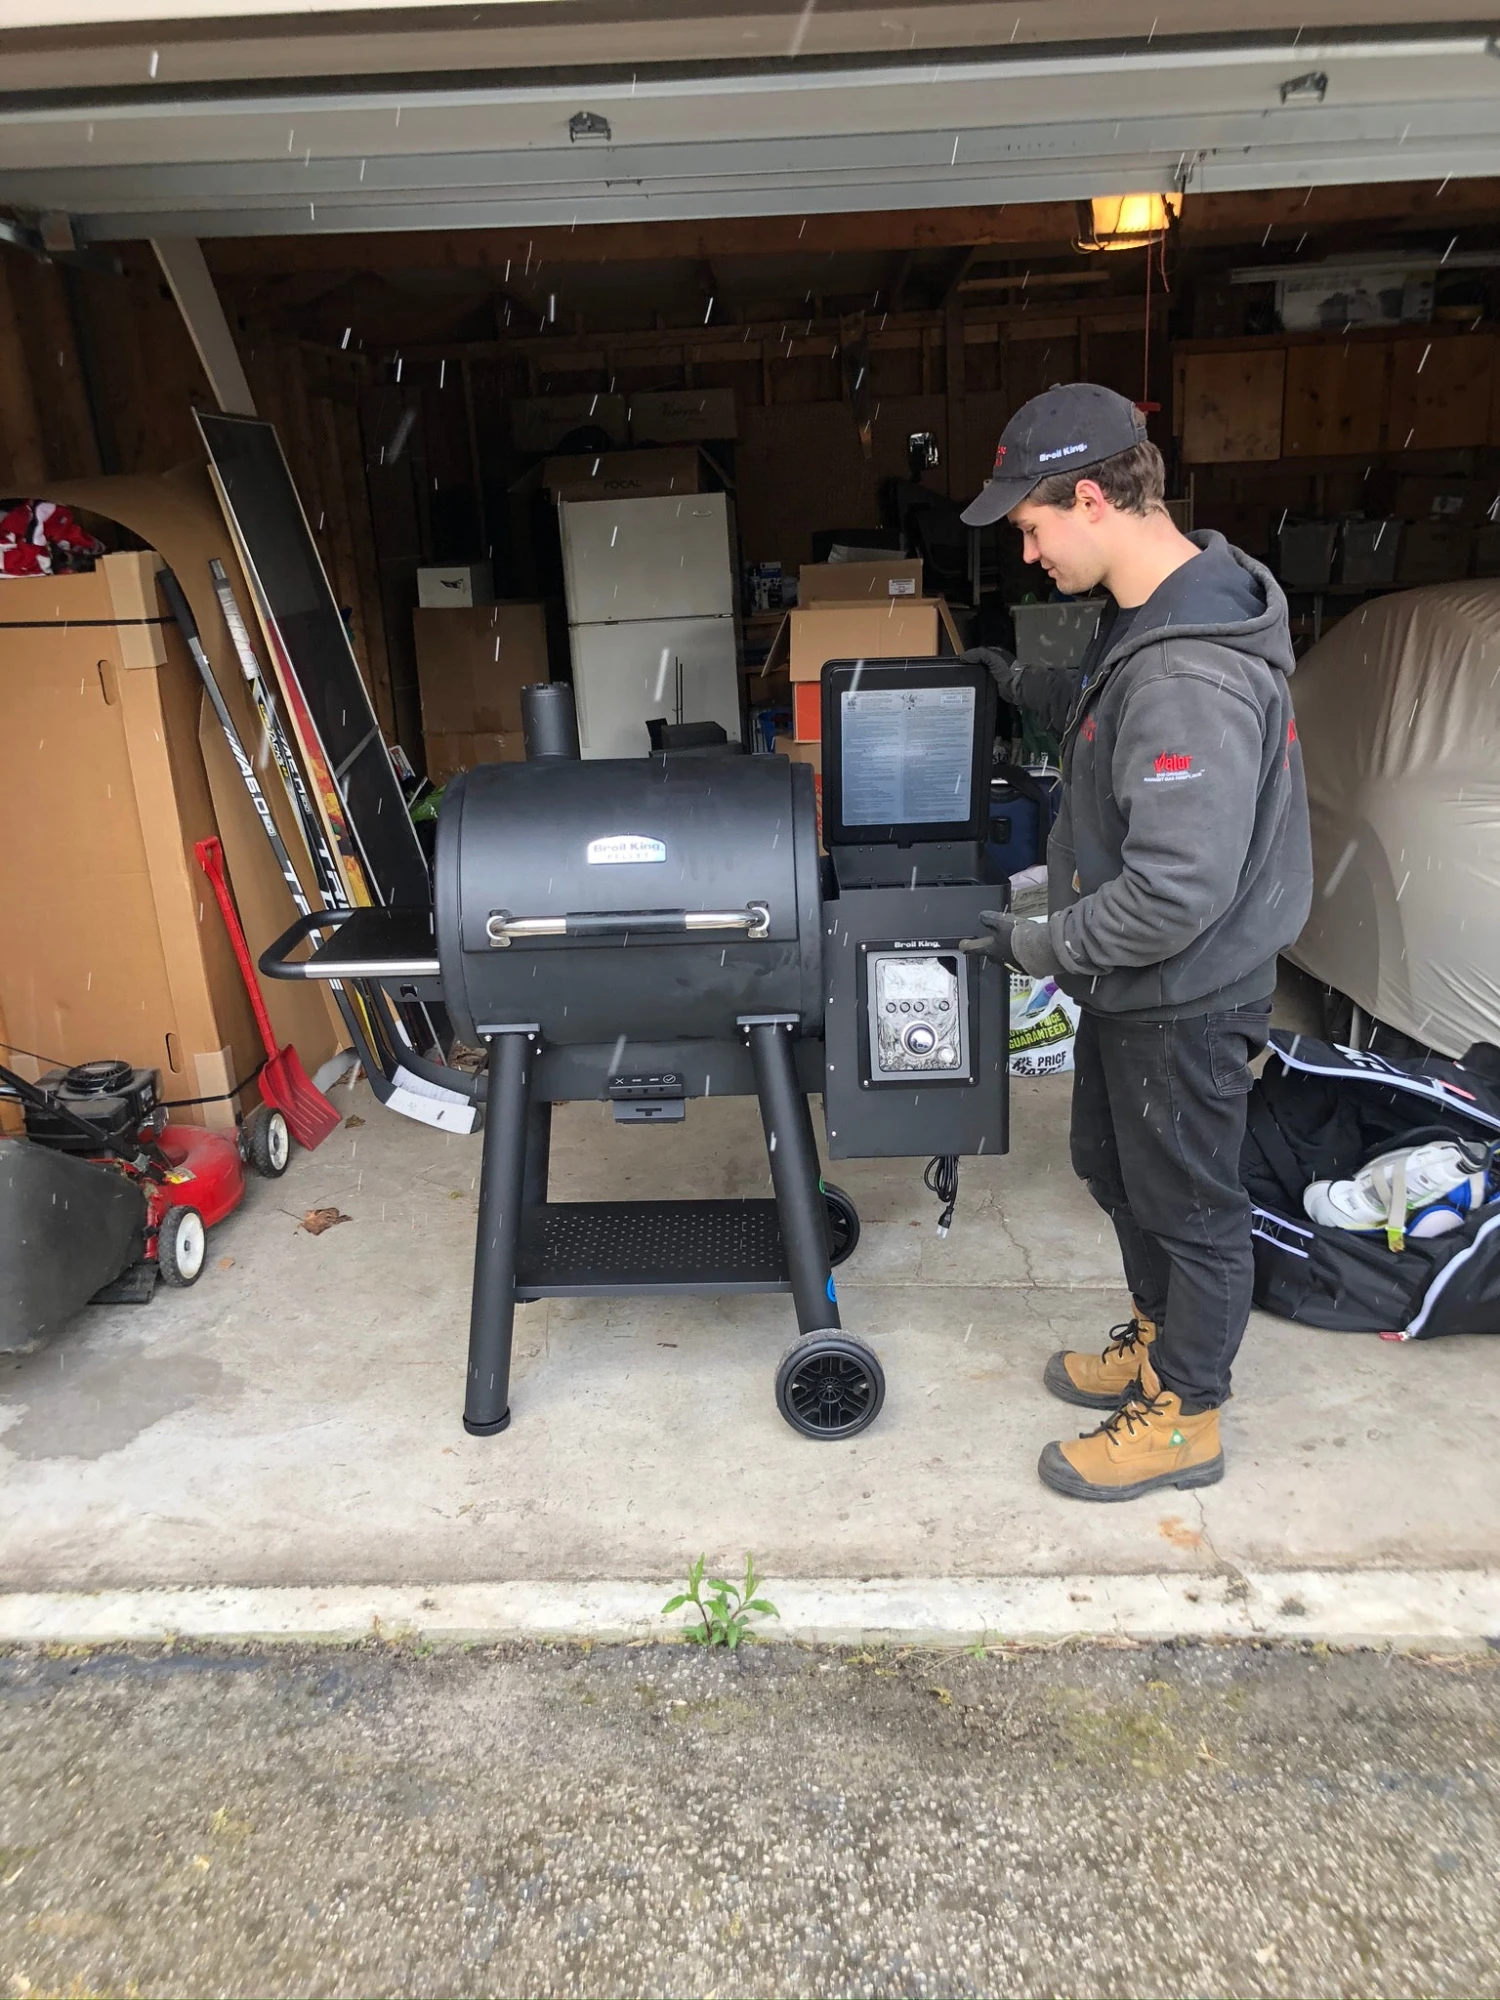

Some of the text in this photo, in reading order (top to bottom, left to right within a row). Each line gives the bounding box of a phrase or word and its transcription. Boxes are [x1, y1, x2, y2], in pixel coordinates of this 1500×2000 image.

[1039, 449, 1063, 462] Broil
[1154, 750, 1192, 773] Valor
[593, 843, 626, 853] Broil
[1008, 1022, 1067, 1049] GUARANTEED
